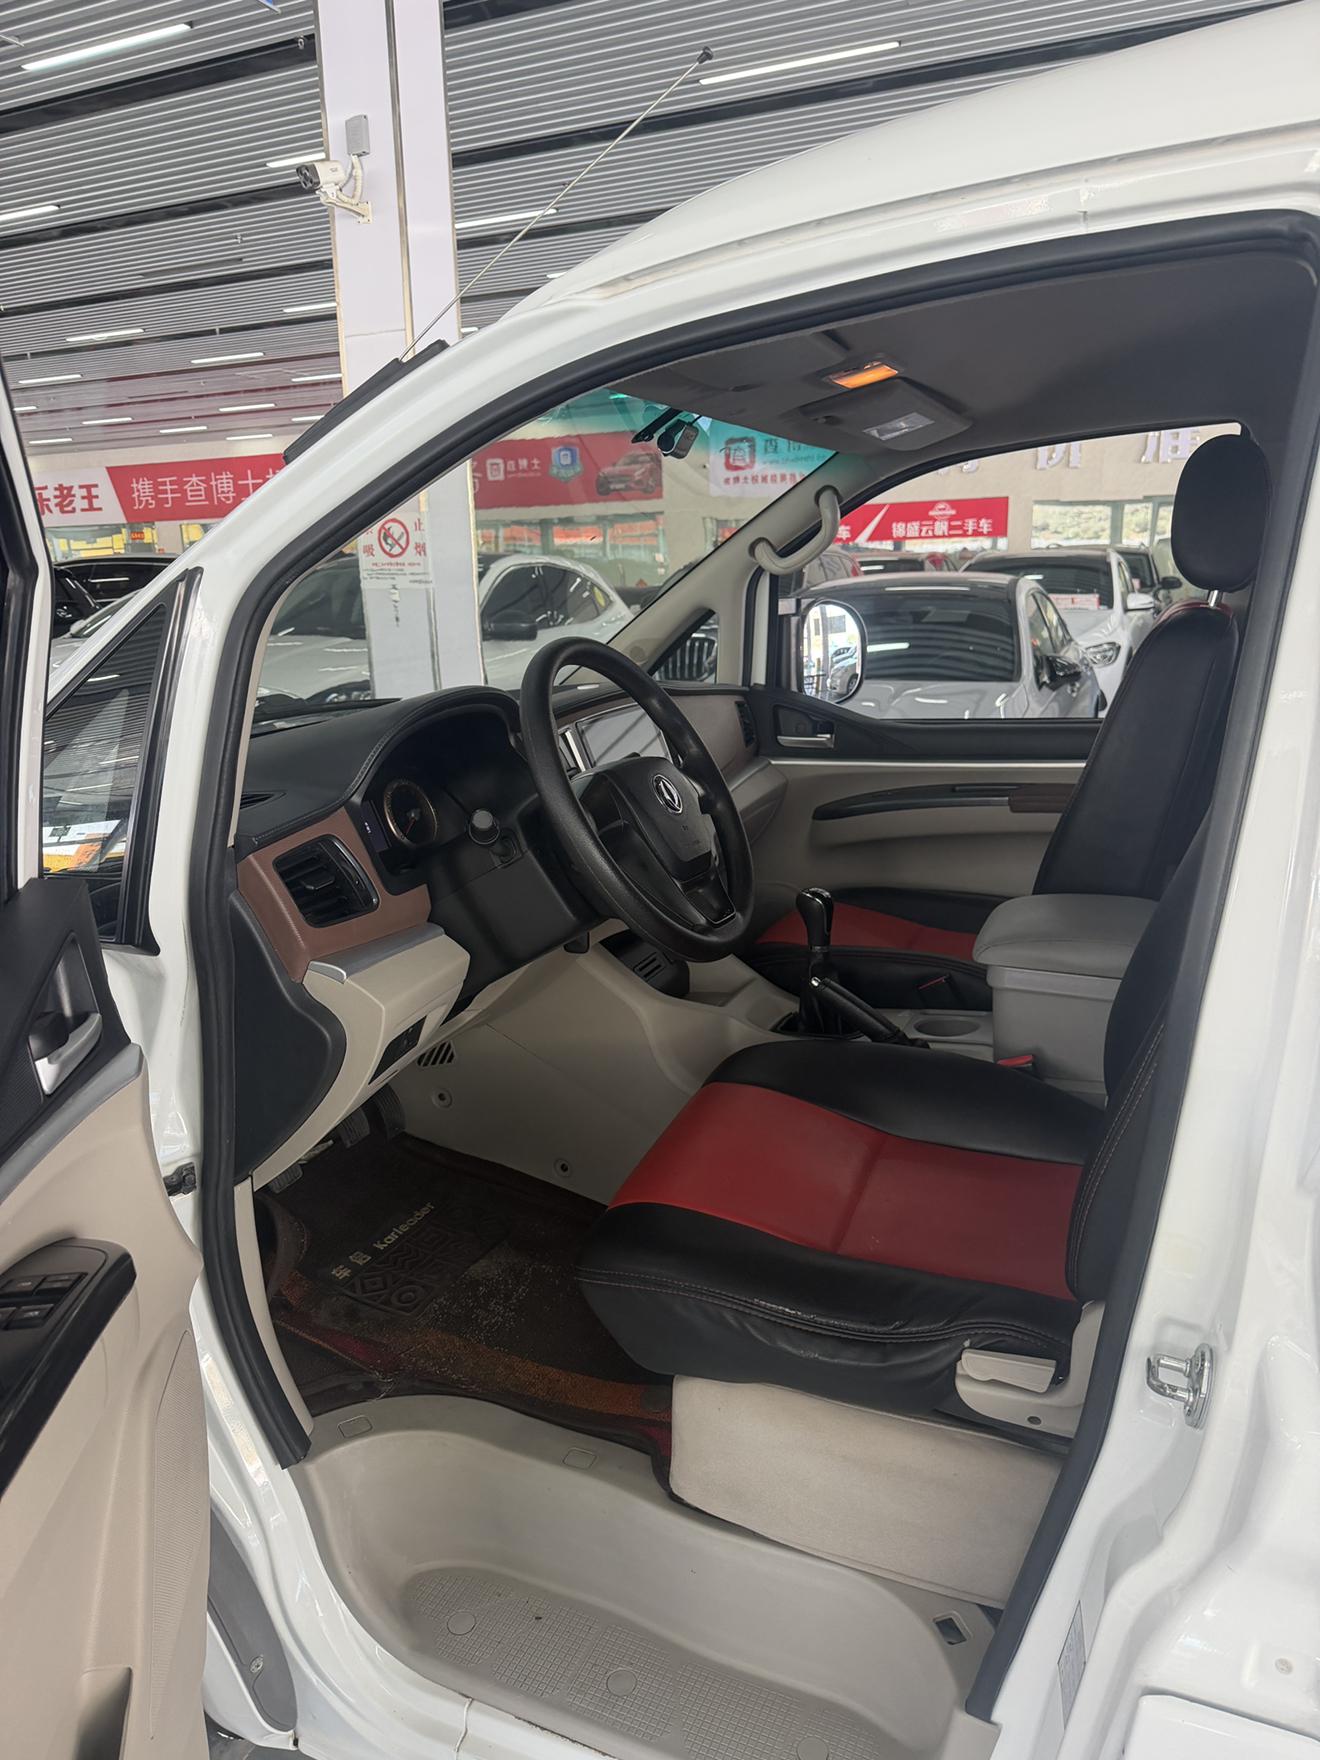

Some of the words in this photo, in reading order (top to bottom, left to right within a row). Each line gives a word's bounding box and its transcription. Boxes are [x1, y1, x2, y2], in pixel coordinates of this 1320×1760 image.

[131, 468, 279, 510] 携手查博士
